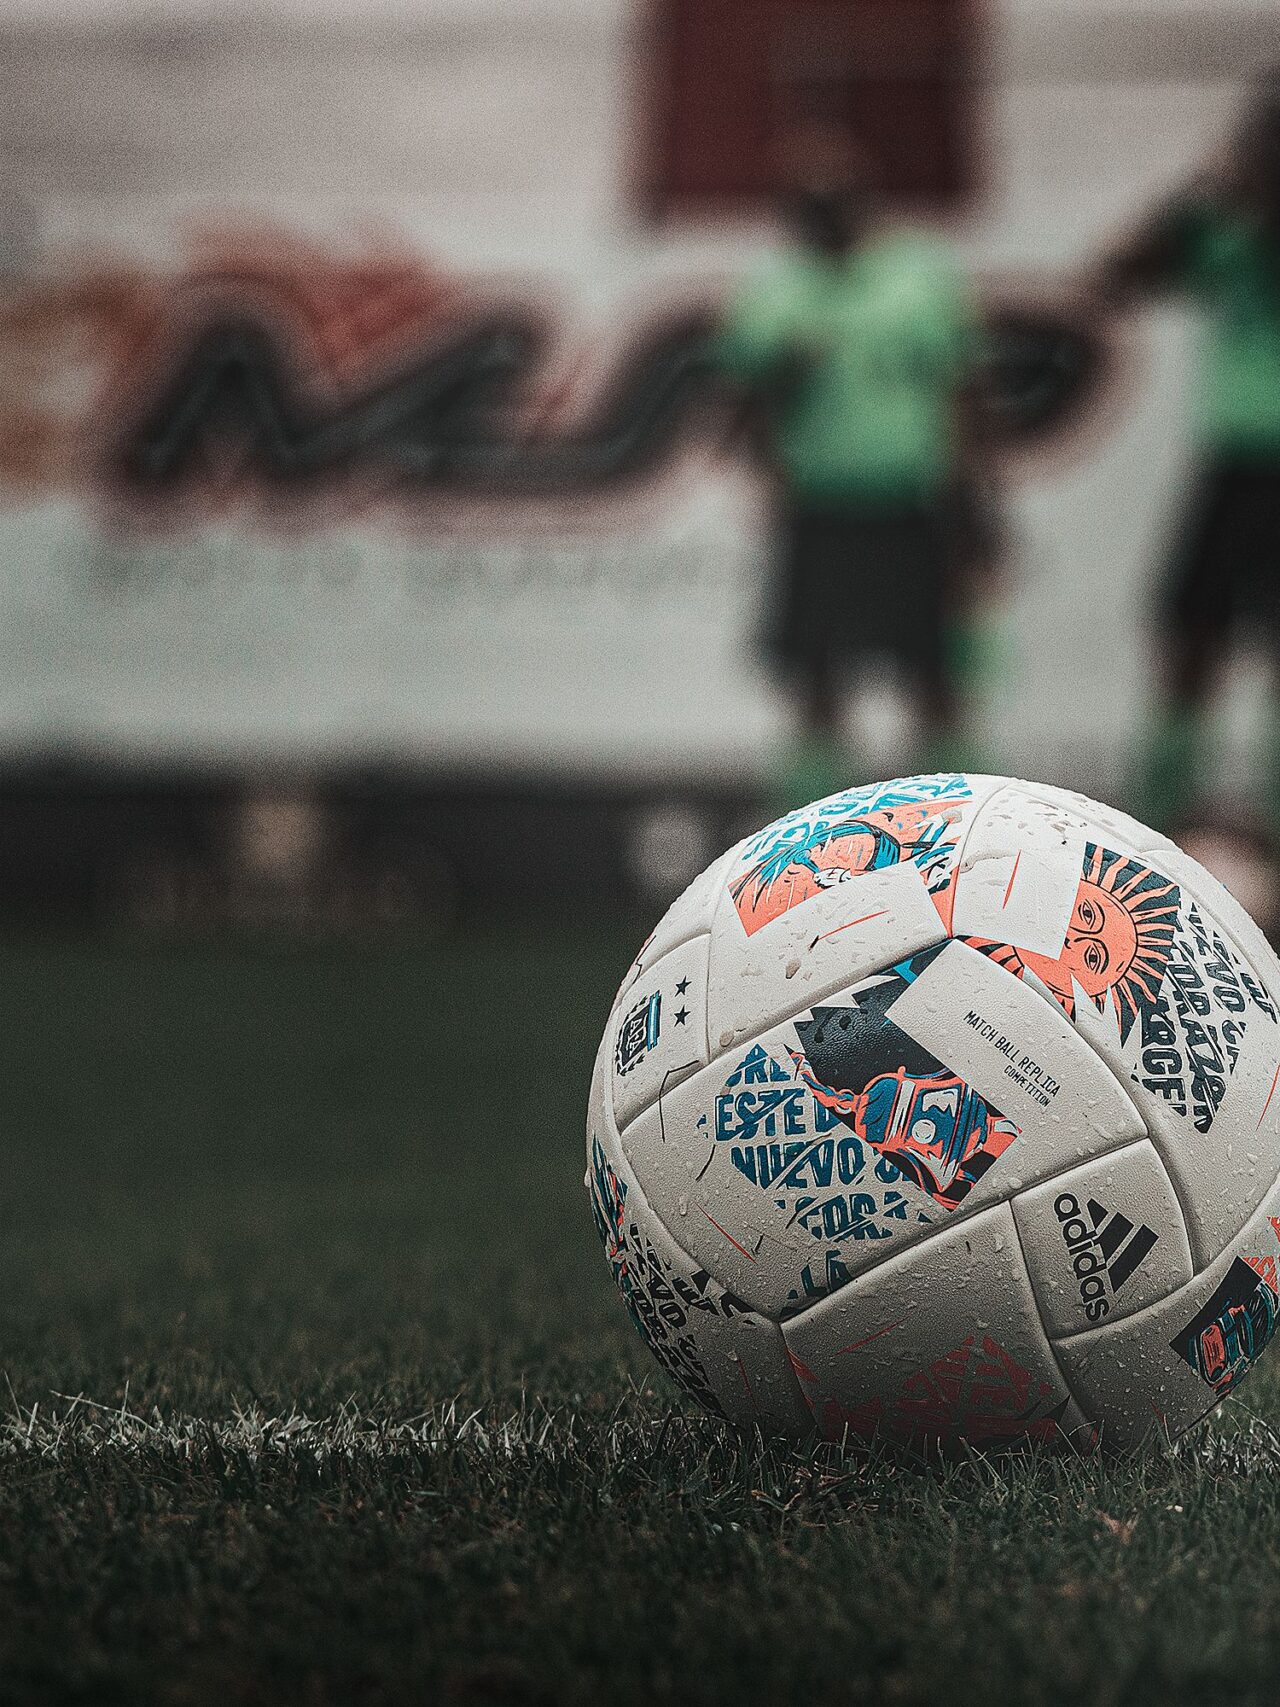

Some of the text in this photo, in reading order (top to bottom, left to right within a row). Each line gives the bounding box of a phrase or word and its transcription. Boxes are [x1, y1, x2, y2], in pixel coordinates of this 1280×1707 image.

[963, 1010, 1061, 1098] MATCH BALL REPLICA
[1003, 1064, 1052, 1108] COMPETITION
[1053, 1192, 1110, 1321] adidas
